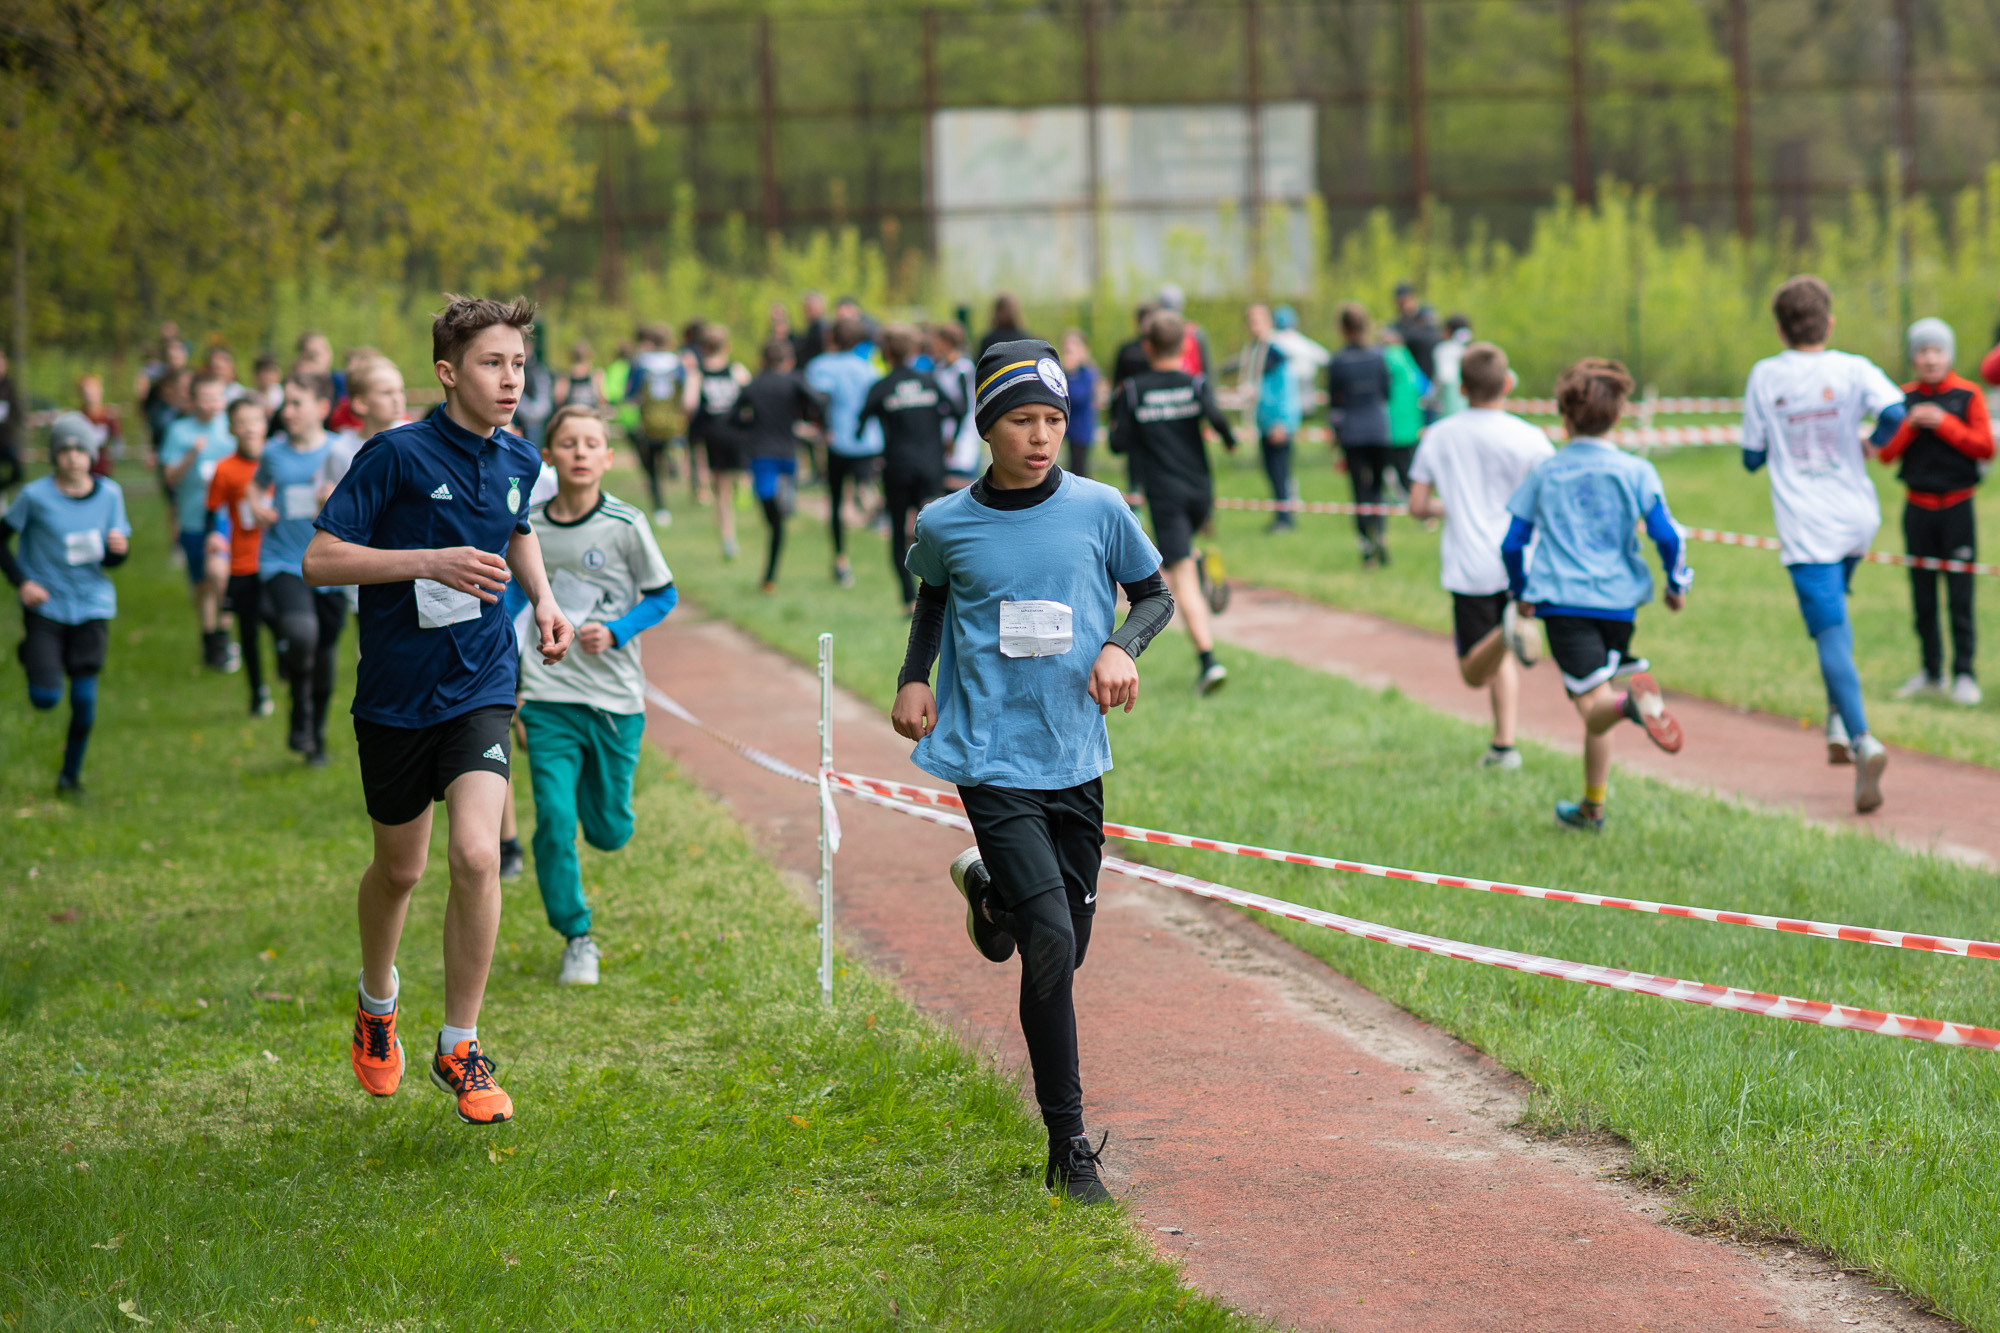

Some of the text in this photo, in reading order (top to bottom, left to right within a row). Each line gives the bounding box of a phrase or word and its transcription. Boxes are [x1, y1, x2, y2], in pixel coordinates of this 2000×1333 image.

[430, 492, 453, 501] adidas
[589, 553, 599, 566] L
[482, 751, 508, 765] adidas
